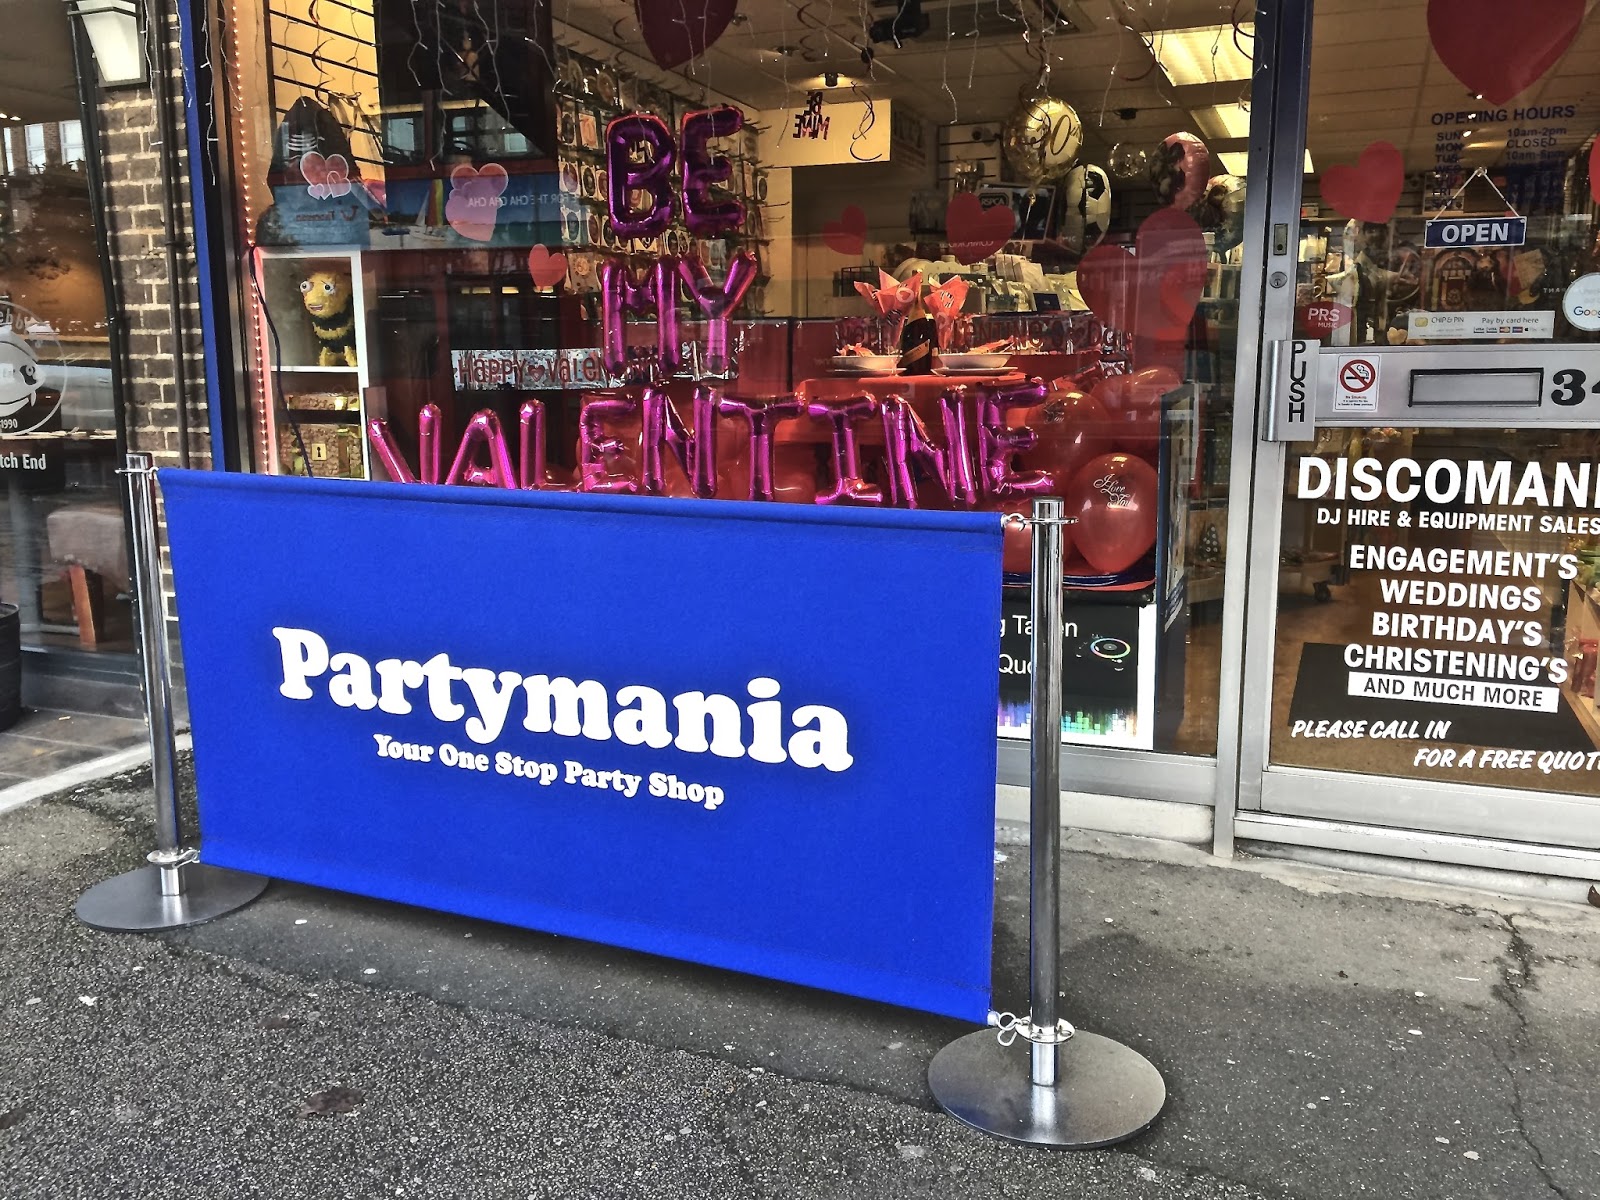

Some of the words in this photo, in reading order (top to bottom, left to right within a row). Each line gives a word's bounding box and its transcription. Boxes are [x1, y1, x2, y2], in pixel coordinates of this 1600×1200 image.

[1431, 109, 1508, 126] OPENING
[1513, 105, 1576, 121] HOURS
[1435, 143, 1464, 151] MON
[1506, 138, 1557, 149] CLOSED
[1436, 132, 1461, 142] SUN
[606, 105, 748, 239] BE
[1441, 223, 1509, 243] OPEN
[601, 250, 759, 377] MY
[1308, 307, 1340, 322] PRS
[1431, 316, 1447, 324] CHIP
[1481, 317, 1494, 325] Pay
[1495, 317, 1505, 325] by
[1288, 340, 1307, 423] PUSH
[368, 377, 1055, 510] VALENTINE
[22, 453, 47, 470] End
[1316, 508, 1341, 525] DJ
[1347, 509, 1390, 526] HIRE
[1397, 510, 1412, 527] &
[1418, 511, 1534, 532] EQUIPMENT
[1539, 515, 1600, 535] SALES
[1349, 545, 1578, 580] ENGAGEMENT'S
[1380, 579, 1542, 612] WEDDINGS
[1372, 612, 1542, 647] BIRTHDAY'S
[1344, 644, 1568, 683] CHRISTENING'S
[272, 626, 854, 772] Partymania
[1363, 677, 1405, 695] AND
[1413, 680, 1475, 701] MUCH
[1483, 686, 1543, 707] MORE
[1291, 720, 1368, 738] PLEASE
[1370, 721, 1420, 739] CALL
[1424, 721, 1451, 739] IN
[373, 733, 434, 763] Your
[439, 742, 489, 772] One
[495, 751, 558, 786] Stop
[564, 760, 642, 798] Party
[648, 772, 725, 810] Shop
[1413, 748, 1455, 767] FOR
[1457, 750, 1474, 768] A
[1479, 750, 1537, 769] FREE
[1537, 750, 1600, 775] QUOT
